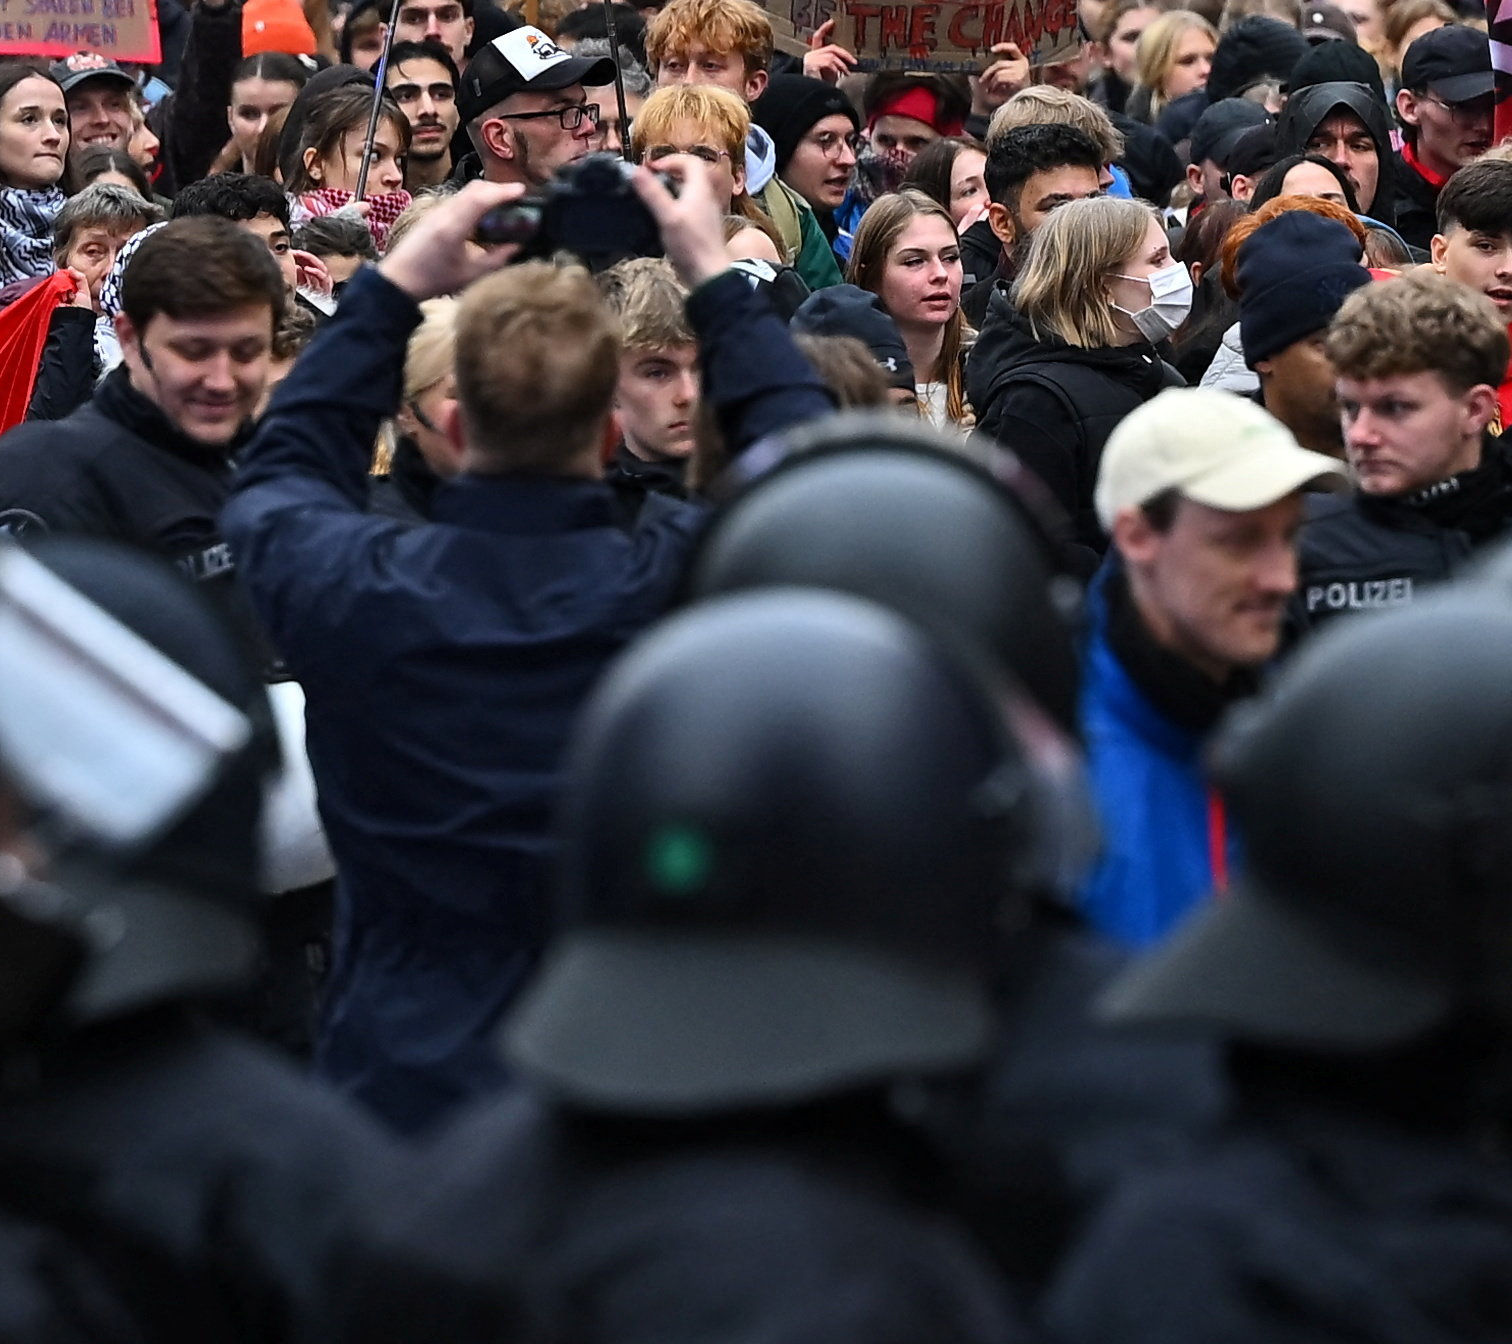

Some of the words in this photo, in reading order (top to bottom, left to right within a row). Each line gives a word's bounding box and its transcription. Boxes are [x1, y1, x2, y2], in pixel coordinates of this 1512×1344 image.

[42, 20, 119, 47] ARMEN
[846, 5, 940, 58] THE
[1306, 578, 1413, 612] POLIZEI
